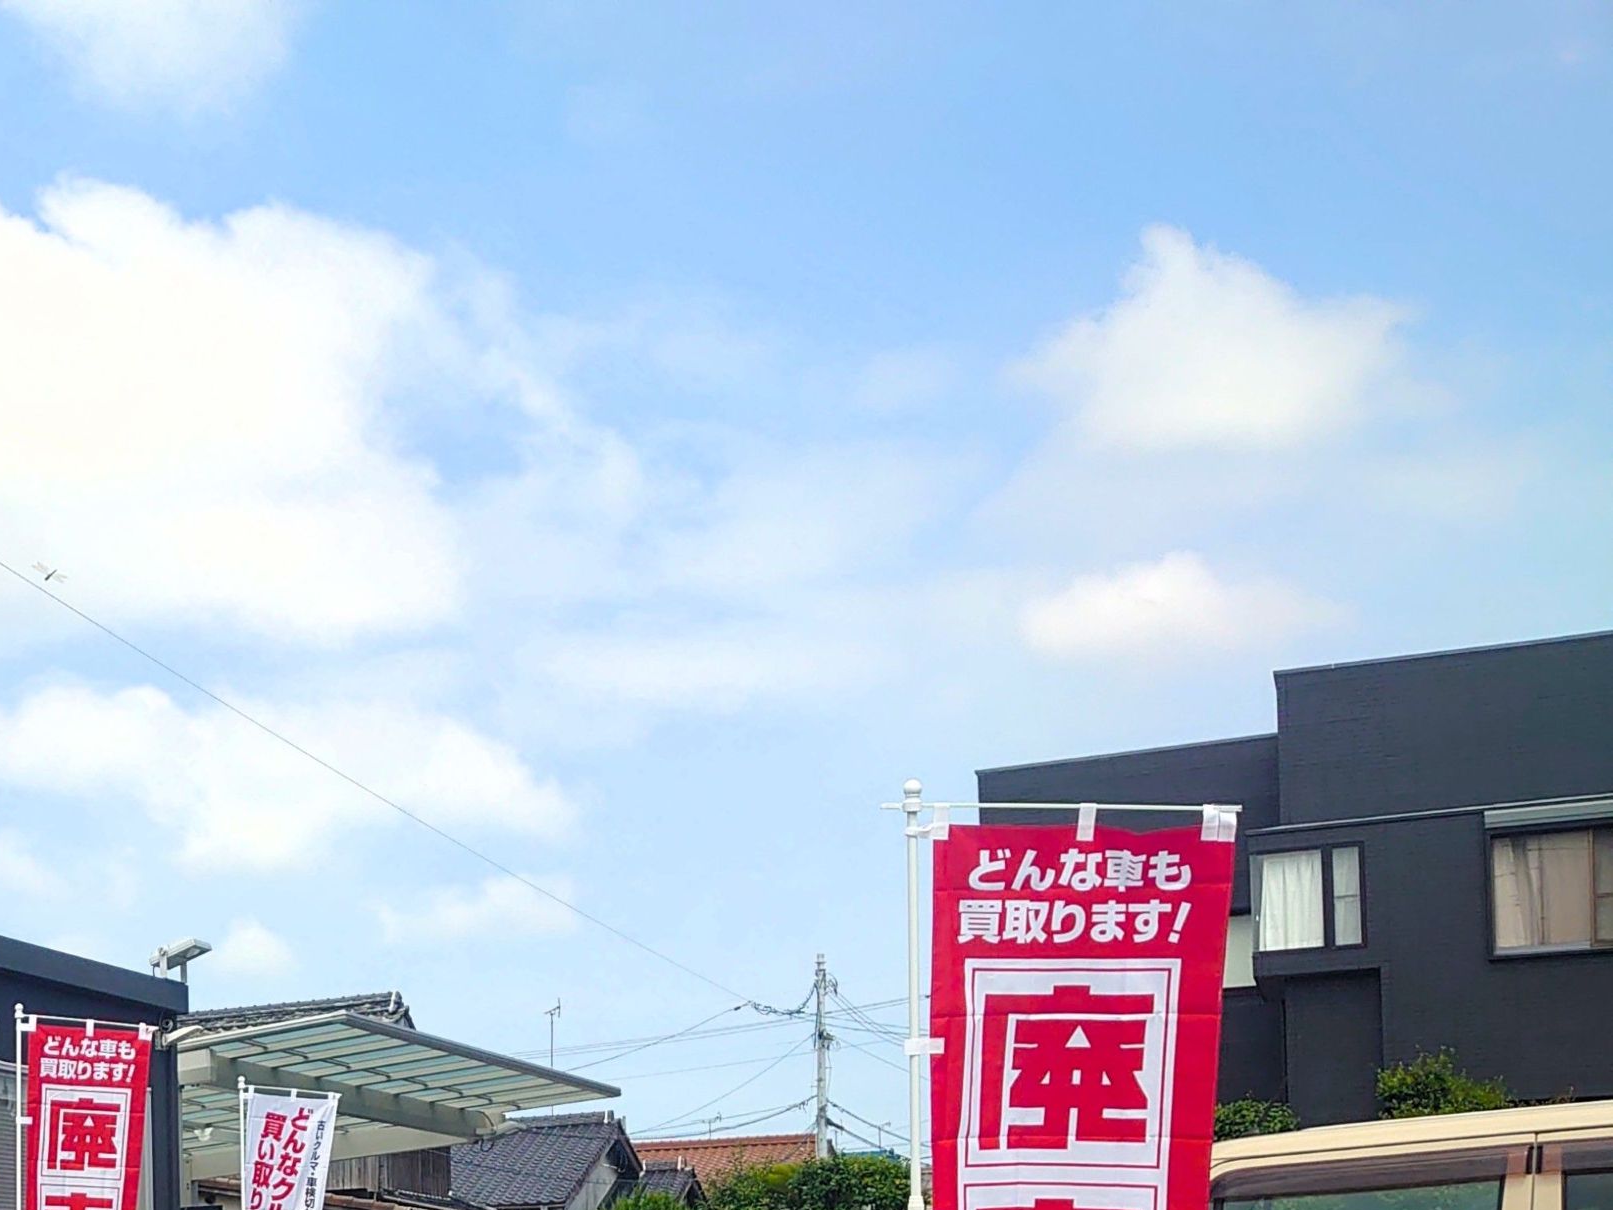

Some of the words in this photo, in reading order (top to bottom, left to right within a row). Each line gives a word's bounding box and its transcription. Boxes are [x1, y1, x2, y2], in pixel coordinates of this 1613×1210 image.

[967, 847, 1193, 893] どんな車も
[956, 898, 1193, 945] 買取ります!
[43, 1035, 136, 1061] どんな車も
[39, 1057, 136, 1083] 買取ります!
